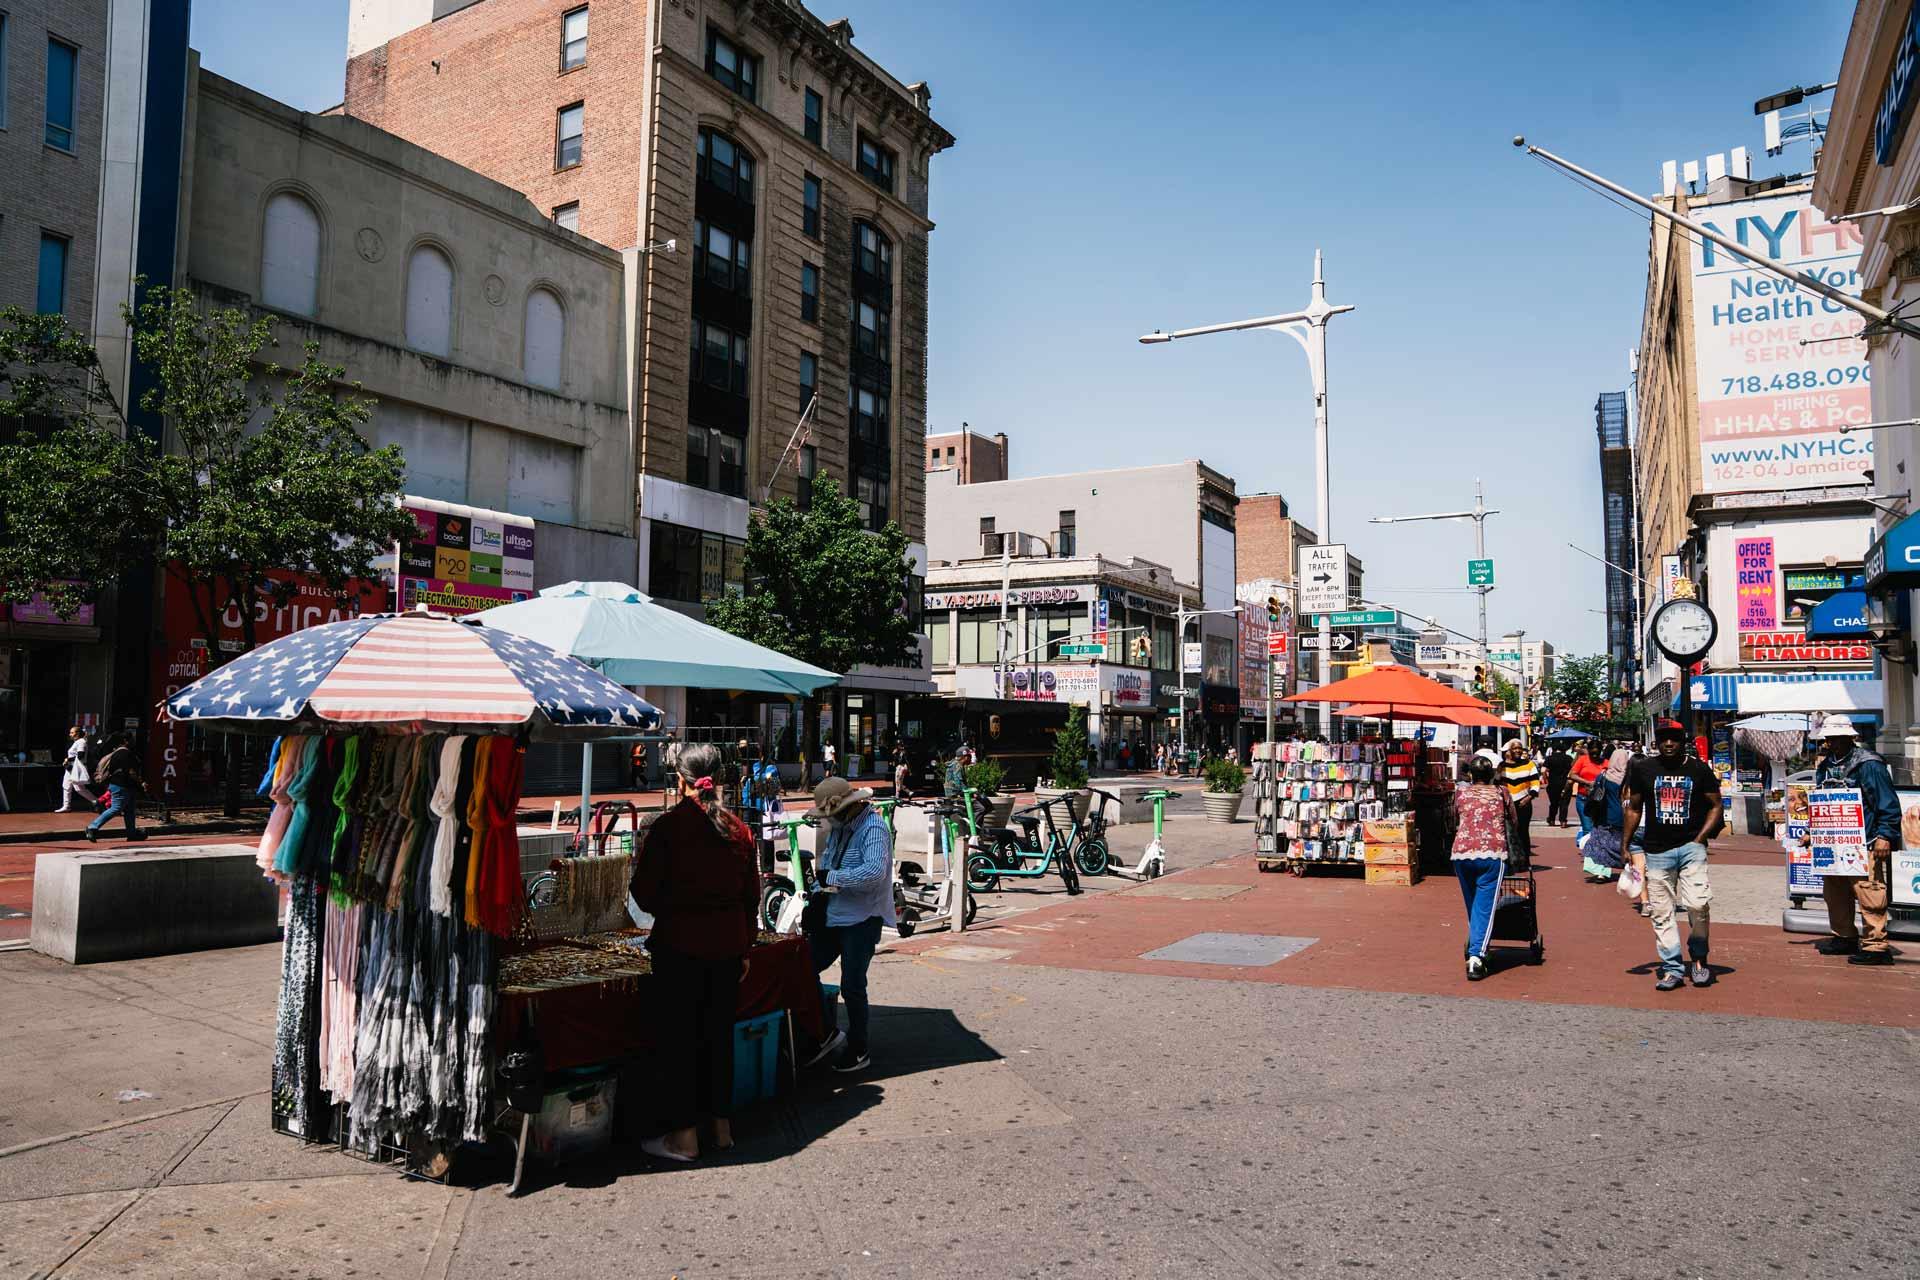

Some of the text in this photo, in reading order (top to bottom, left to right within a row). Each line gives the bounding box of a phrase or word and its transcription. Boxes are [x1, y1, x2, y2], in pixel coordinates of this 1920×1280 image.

[1874, 10, 1914, 165] CHASE
[1731, 266, 1857, 300] New Yor
[1712, 295, 1814, 326] Health
[1729, 318, 1865, 348] HOME CAR
[1744, 338, 1868, 364] SERVICES
[1773, 393, 1840, 411] HIRING
[1714, 405, 1872, 435] HHA's & PC
[1714, 458, 1870, 481] 162-04 Jamaica
[443, 533, 464, 543] boost
[1312, 549, 1333, 559] ALL
[1738, 543, 1772, 557] OFFICE
[408, 558, 432, 568] smart
[1308, 562, 1338, 570] TRAFFIC
[1743, 558, 1767, 568] FOR
[1739, 570, 1773, 584] RENT
[416, 591, 470, 609] ELECTRONICS
[1317, 601, 1336, 609] BUSES
[1750, 599, 1763, 607] CALL
[1332, 613, 1374, 623] Union Hall St
[1747, 608, 1766, 617] (516)
[1740, 618, 1775, 628] 659-7621
[1833, 618, 1868, 627] CHAS
[1306, 638, 1320, 646] ON
[1754, 646, 1868, 660] FLAVORS
[169, 664, 200, 677] OPTICAL
[1116, 672, 1142, 688] metro
[1655, 776, 1691, 787] NEVER
[1661, 788, 1685, 799] GIVE
[1670, 800, 1684, 812] UP
[1811, 804, 1857, 817] FREE
